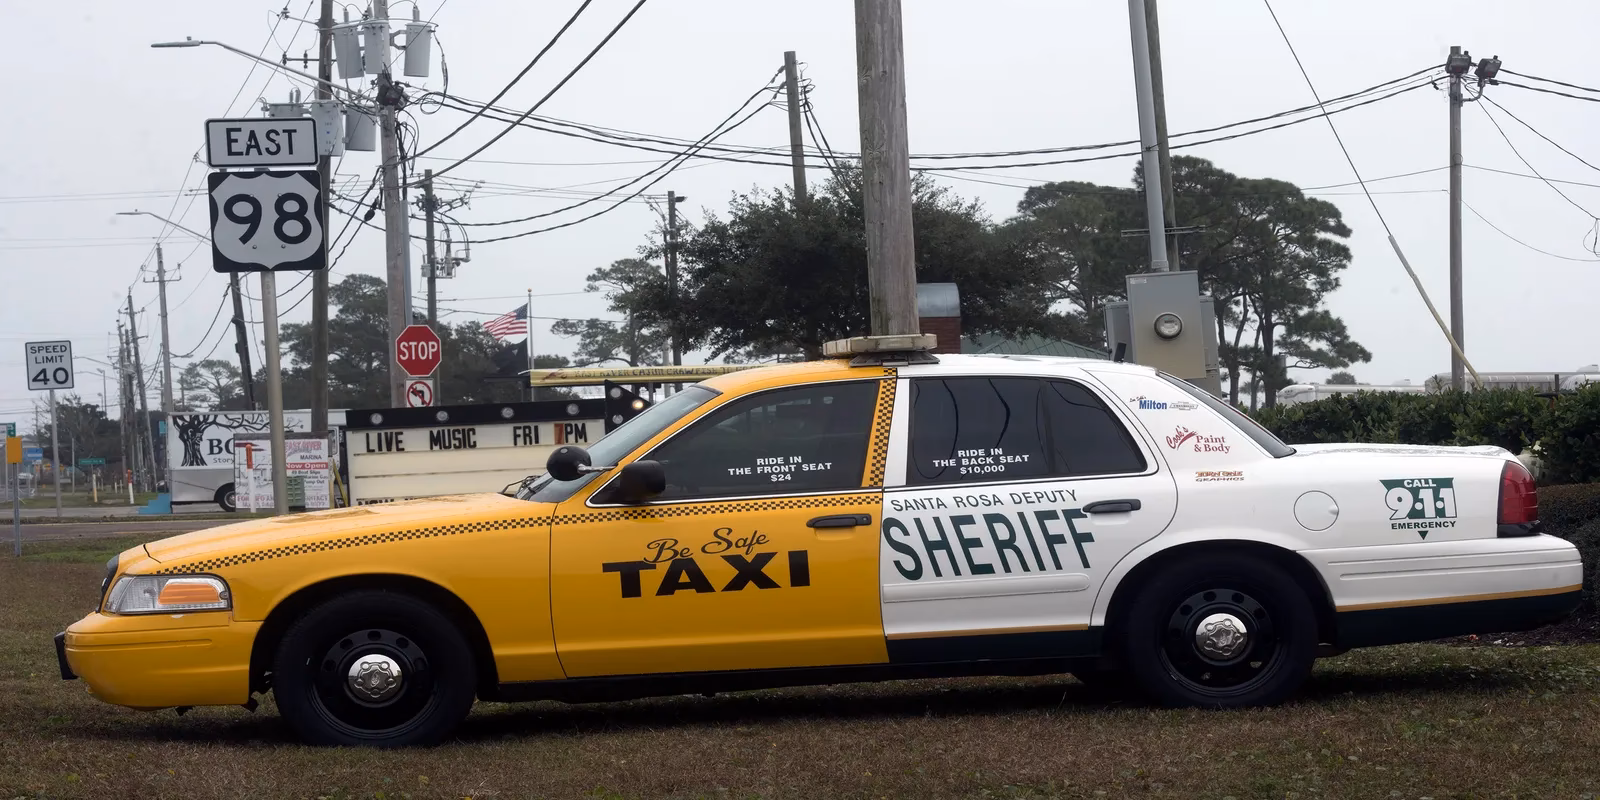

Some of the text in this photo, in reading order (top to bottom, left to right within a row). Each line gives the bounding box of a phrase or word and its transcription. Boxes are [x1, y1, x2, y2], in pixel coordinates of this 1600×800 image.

[226, 128, 298, 156] EAST
[224, 192, 312, 245] 98
[30, 345, 67, 354] SPEED
[399, 341, 438, 360] STOP
[35, 355, 64, 364] LIMIT
[32, 367, 69, 385] 40
[1138, 400, 1167, 410] Milton
[366, 423, 588, 453] LIVE MUSIC FRI 7PM
[1196, 435, 1226, 443] Paint
[958, 448, 1003, 457] RIDE IN
[1194, 443, 1231, 454] & Body
[304, 462, 326, 470] Open
[757, 457, 784, 466] RIDE
[933, 454, 1030, 467] THE BACK SEAT
[727, 462, 832, 475] THE FRONT SEAT
[960, 465, 1005, 475] $10,000
[770, 474, 792, 482] $24
[1403, 479, 1437, 488] CALL
[890, 489, 1078, 512] SANTA ROSA DEPUTY
[1391, 521, 1456, 530] EMERGENCY
[643, 527, 770, 563] Be Safe
[882, 508, 1095, 581] SHERIFF
[602, 550, 810, 598] TAXI
